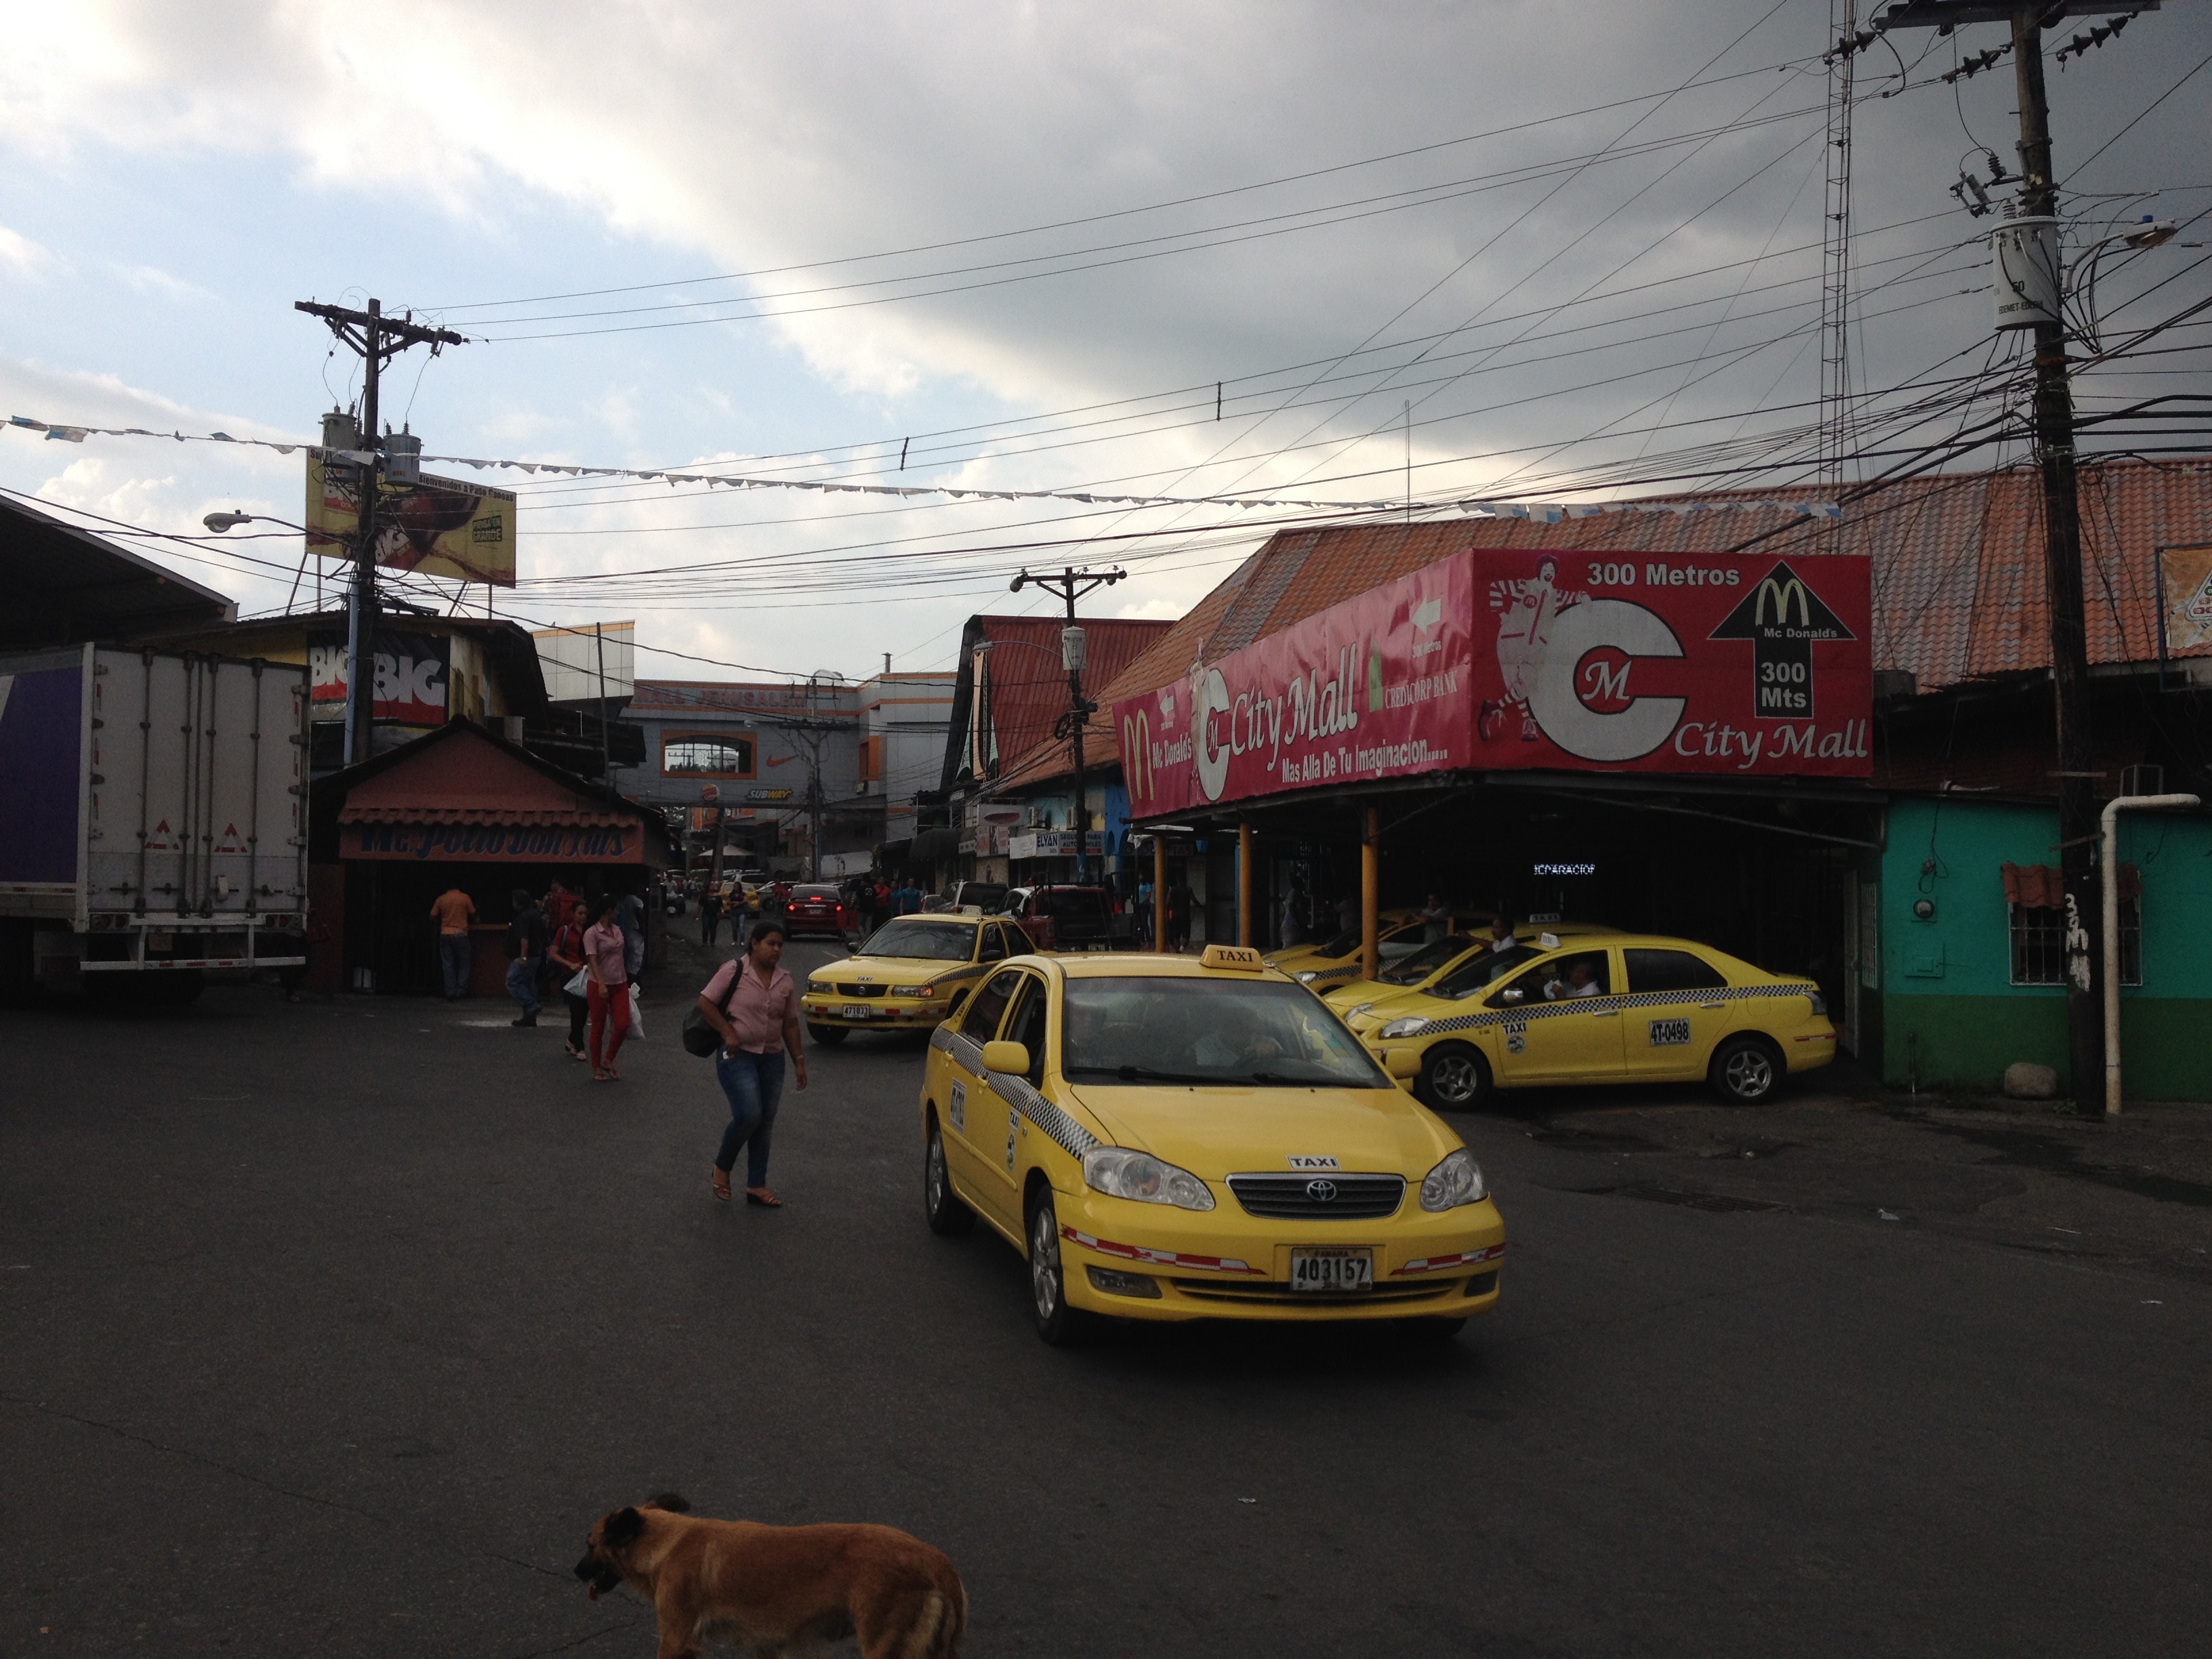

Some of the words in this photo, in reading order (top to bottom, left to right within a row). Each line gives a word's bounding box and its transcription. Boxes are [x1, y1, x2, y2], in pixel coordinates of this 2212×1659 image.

[419, 474, 462, 491] Bienvenidos
[470, 485, 487, 496] Paso
[1586, 562, 1636, 586] 300
[1645, 563, 1740, 586] Metros
[1764, 628, 1782, 638] Mc
[1786, 628, 1837, 638] Donald's
[373, 652, 446, 708] BIG
[1761, 662, 1806, 682] 300
[1385, 678, 1432, 709] CREDICORP
[1761, 687, 1807, 708] Mts
[1231, 684, 1283, 772] City
[1284, 642, 1358, 745] Mall
[1675, 720, 1763, 769] City
[1767, 718, 1868, 759] Mall
[1282, 758, 1300, 783] Mas
[1302, 753, 1321, 781] Alla
[1323, 751, 1336, 778] De
[1338, 747, 1352, 775] Tu
[747, 789, 792, 799] SUBWAY
[1037, 834, 1058, 848] ELYAN
[1217, 950, 1253, 962] TAXI
[1502, 1022, 1527, 1035] TAXI
[1651, 1022, 1689, 1042] 4T-0498
[1291, 1158, 1338, 1167] TAXI
[1297, 1258, 1368, 1282] 403157
